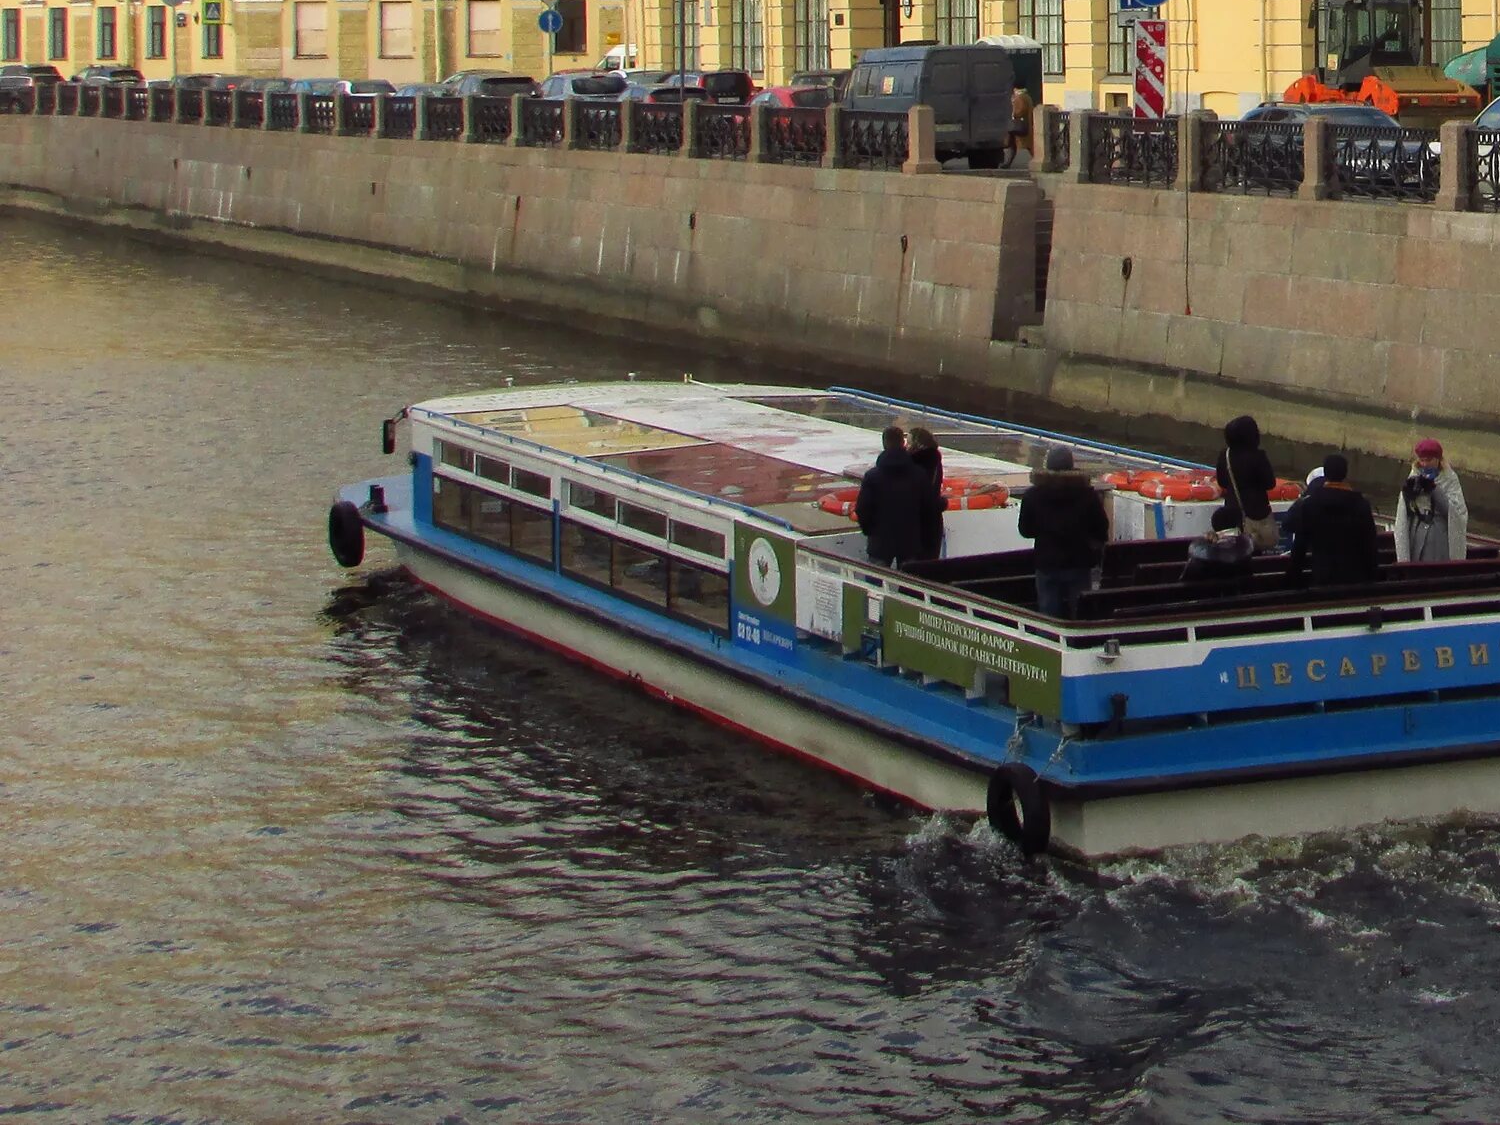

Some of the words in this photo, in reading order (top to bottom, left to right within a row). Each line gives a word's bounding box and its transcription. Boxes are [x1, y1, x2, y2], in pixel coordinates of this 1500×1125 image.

[919, 611, 980, 643] ИМПЕРАТОРСКИЙ
[980, 633, 1015, 653] ФАРФОР
[925, 631, 958, 654] ПОДАРОК
[969, 647, 1048, 683] САНКТ-ПЕТЕРБУРГА!
